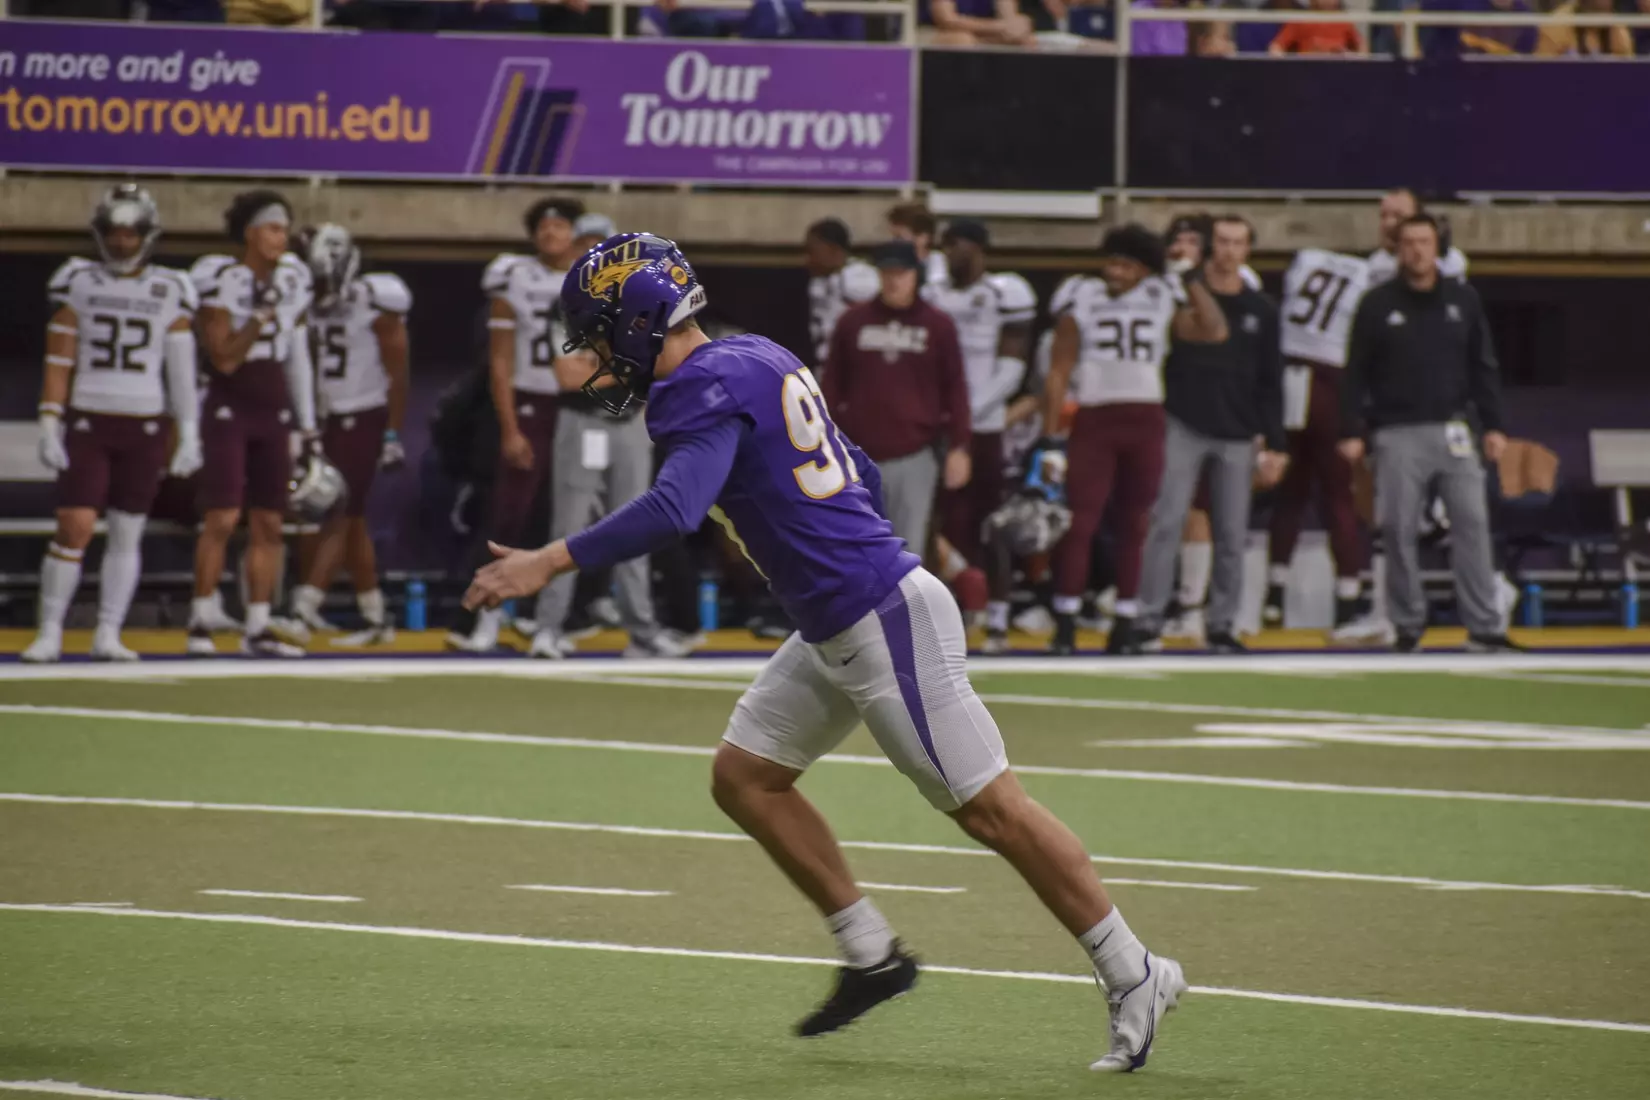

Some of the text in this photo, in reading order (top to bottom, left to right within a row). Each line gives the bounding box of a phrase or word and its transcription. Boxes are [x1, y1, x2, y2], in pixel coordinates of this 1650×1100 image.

[24, 53, 110, 80] more
[117, 50, 184, 82] and
[190, 50, 260, 91] give
[665, 50, 771, 101] Our
[621, 93, 892, 150] Tomorrow
[579, 238, 641, 292] UNI
[1288, 267, 1351, 332] 91
[90, 313, 152, 374] 32
[1096, 317, 1155, 362] 36
